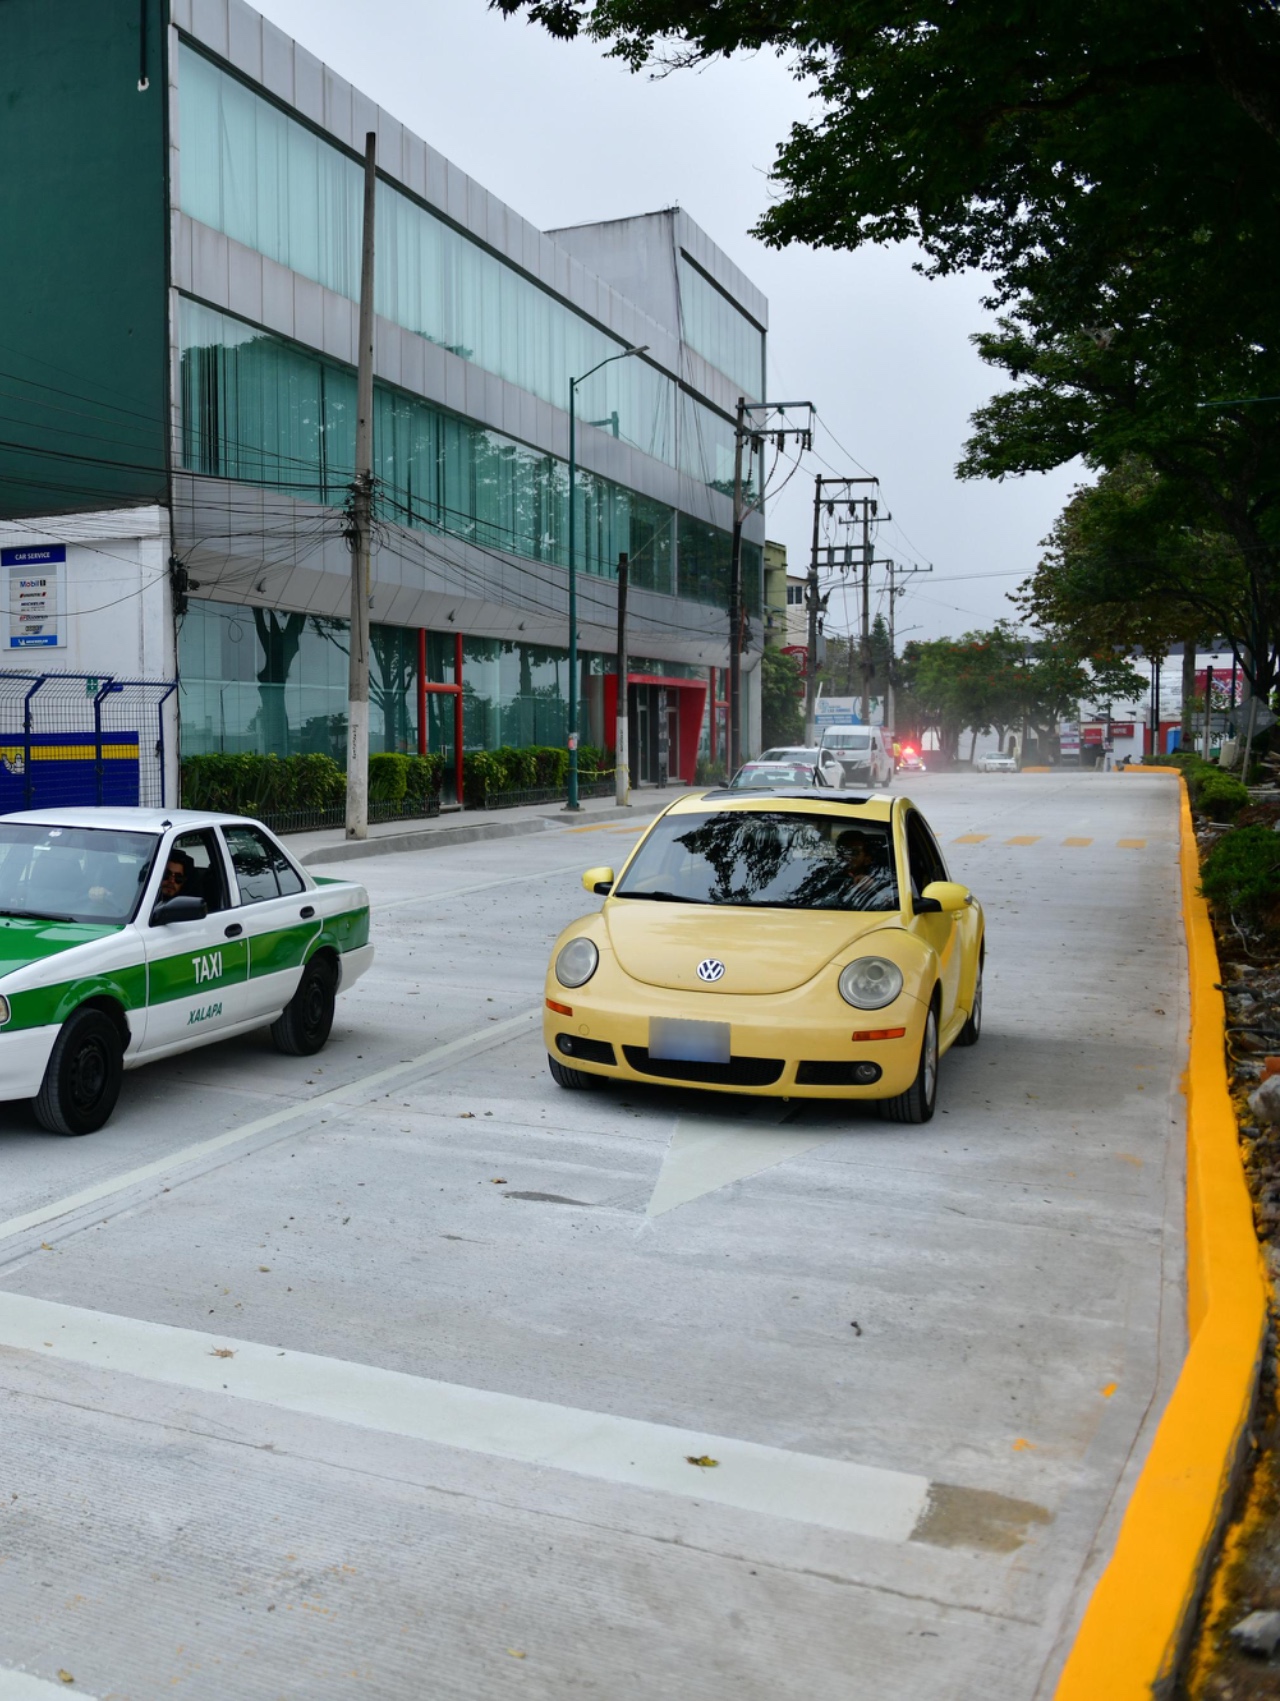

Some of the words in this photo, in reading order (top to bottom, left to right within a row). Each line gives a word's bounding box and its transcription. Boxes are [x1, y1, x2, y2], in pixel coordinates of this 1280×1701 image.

[15, 553, 26, 561] CAR
[27, 551, 51, 560] SERVICE
[20, 579, 39, 588] Mobil
[192, 951, 223, 985] TAXI
[186, 1002, 223, 1026] XALAPA
